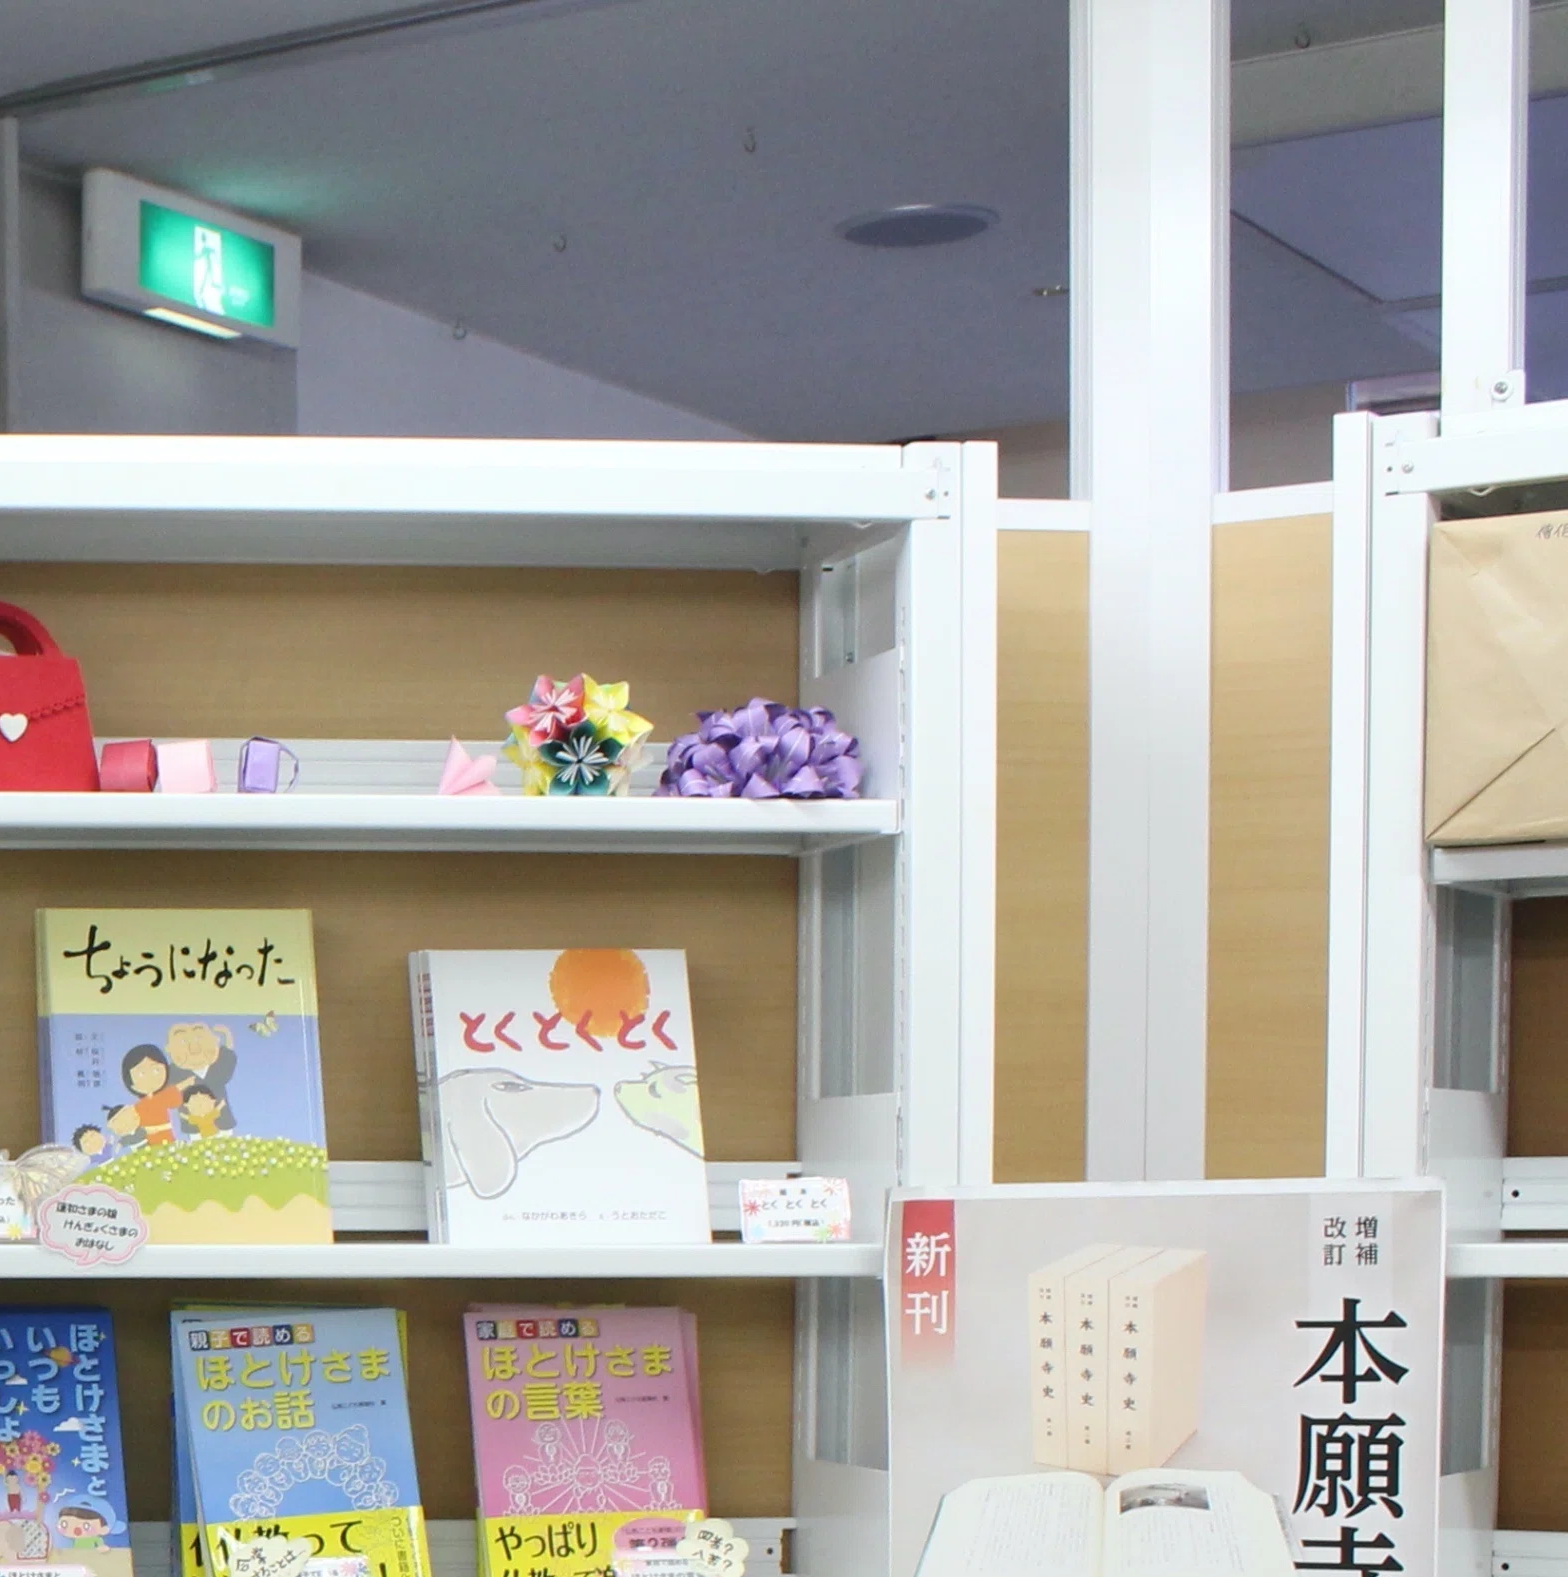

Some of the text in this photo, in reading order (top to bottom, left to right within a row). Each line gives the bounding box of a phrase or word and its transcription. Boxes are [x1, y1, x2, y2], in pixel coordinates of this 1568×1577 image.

[63, 924, 296, 994] ちょうになった
[1323, 1216, 1348, 1267] 改訂
[1354, 1216, 1378, 1267] 増補
[905, 1232, 952, 1335] 新刊
[190, 1324, 316, 1350] 親子で読める
[477, 1319, 600, 1341] 家庭で読める
[26, 1326, 61, 1415] いつも
[194, 1347, 390, 1392] ほとけさま
[481, 1345, 673, 1380] ほとけさま
[69, 1323, 110, 1498] ほとけさまと
[200, 1389, 317, 1432] のお話
[484, 1380, 606, 1422] の言葉
[495, 1521, 599, 1561] やっぱり
